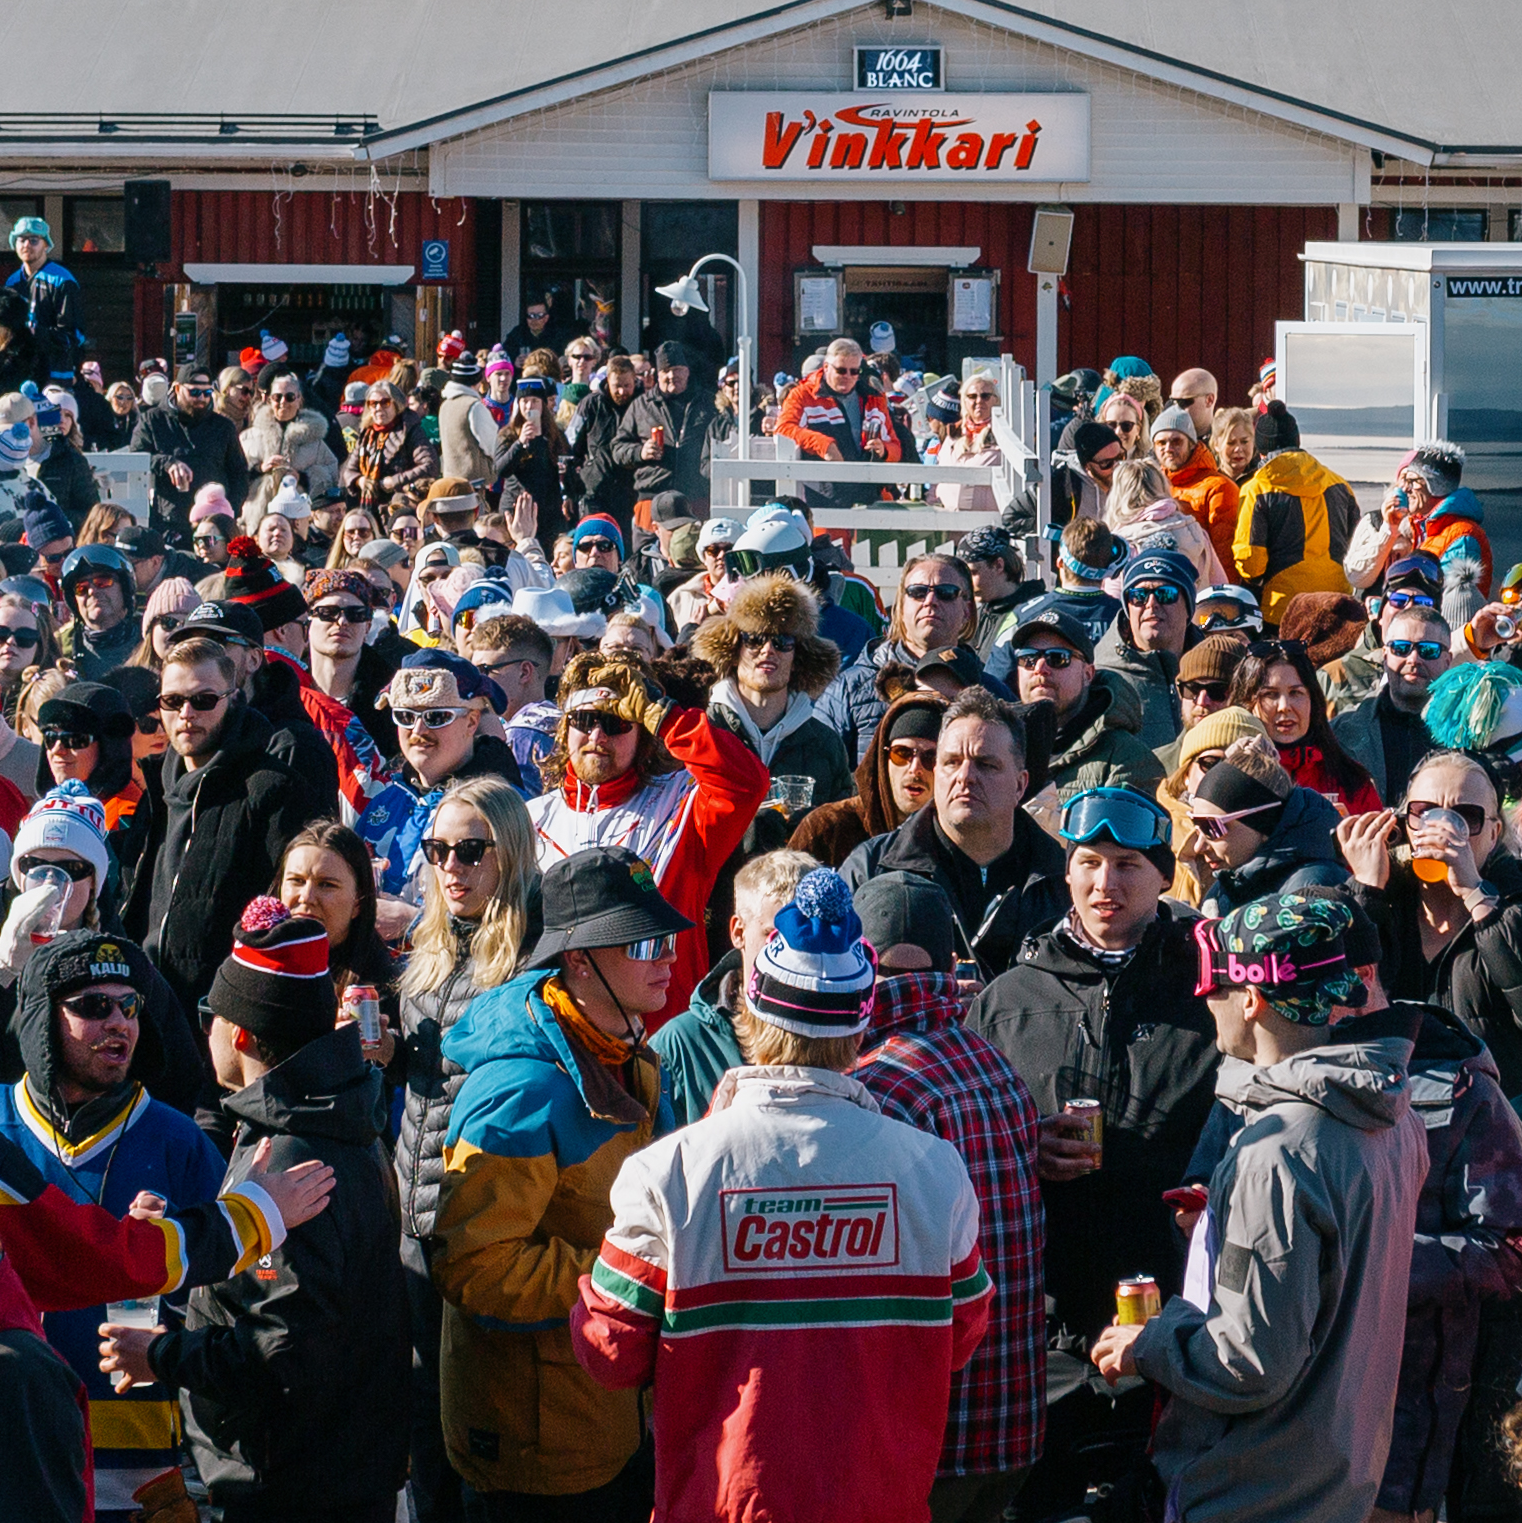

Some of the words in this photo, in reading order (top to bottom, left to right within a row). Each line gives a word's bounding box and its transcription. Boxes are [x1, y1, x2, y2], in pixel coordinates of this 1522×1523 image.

[875, 49, 922, 72] 1664
[866, 72, 934, 89] BLANC
[870, 108, 961, 118] RAVINTOLA
[762, 109, 1043, 171] V'inkkari
[1228, 953, 1298, 985] bollé
[744, 1198, 822, 1215] team
[733, 1211, 887, 1262] Castrol
